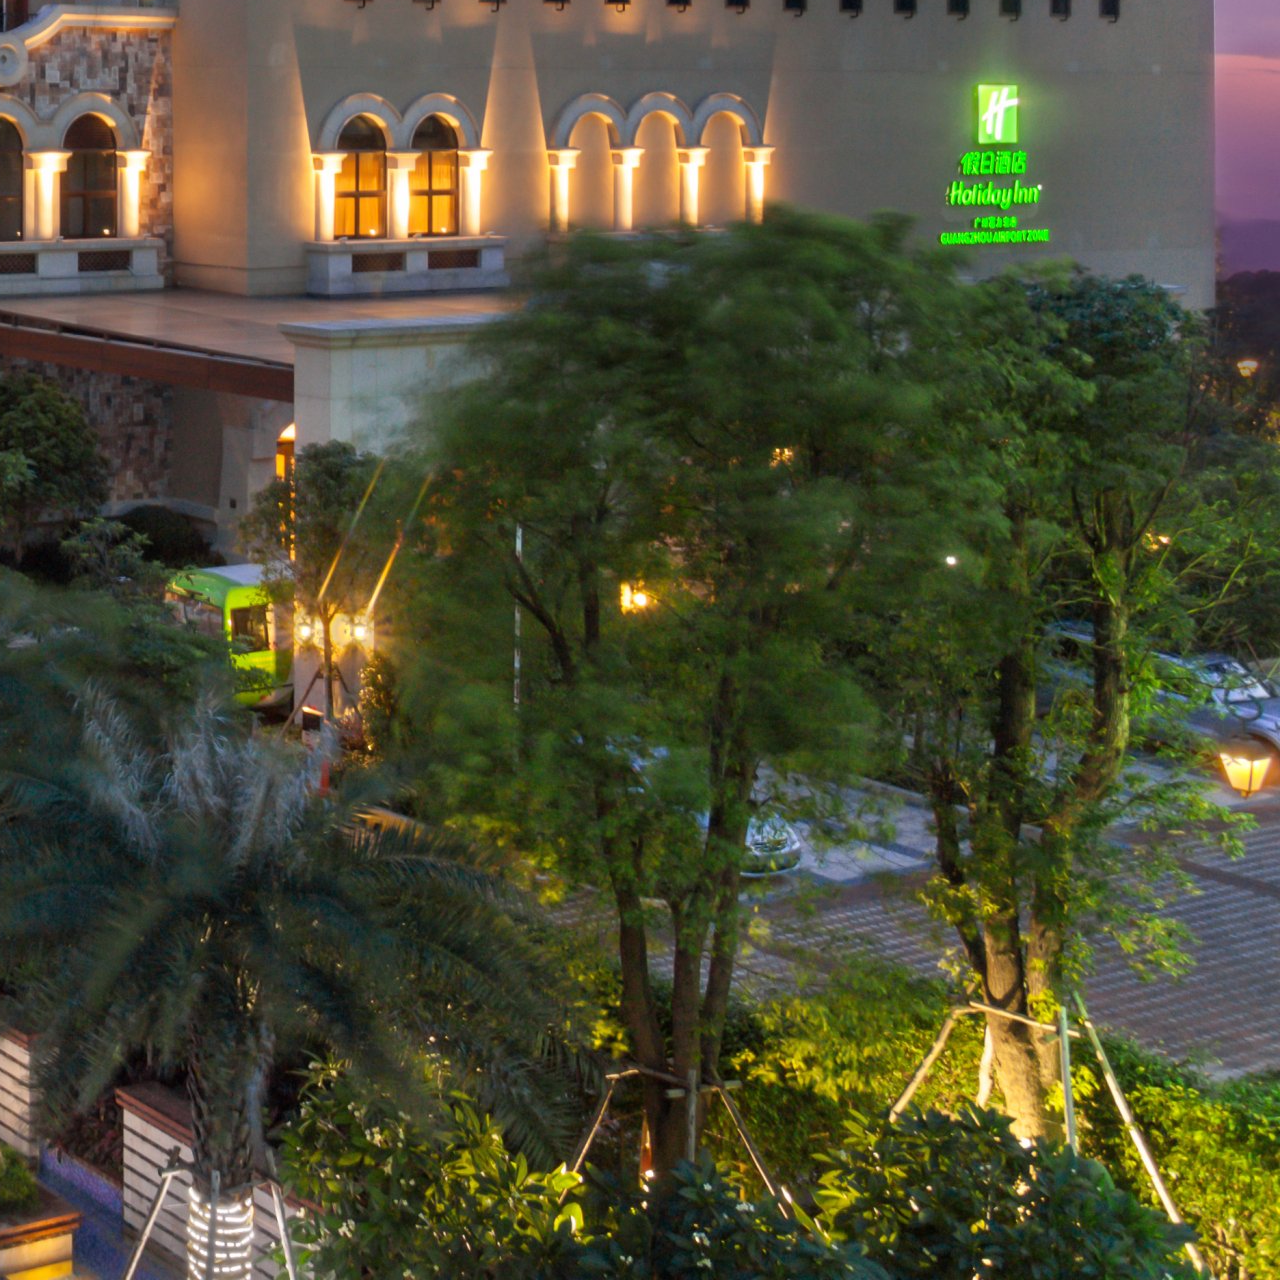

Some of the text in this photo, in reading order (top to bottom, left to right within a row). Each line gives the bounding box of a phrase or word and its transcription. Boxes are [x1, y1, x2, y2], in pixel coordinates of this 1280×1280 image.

[960, 149, 1028, 175] 假日酒店
[948, 179, 1040, 210] Holiday Inn
[940, 231, 993, 245] GUANGZHOU
